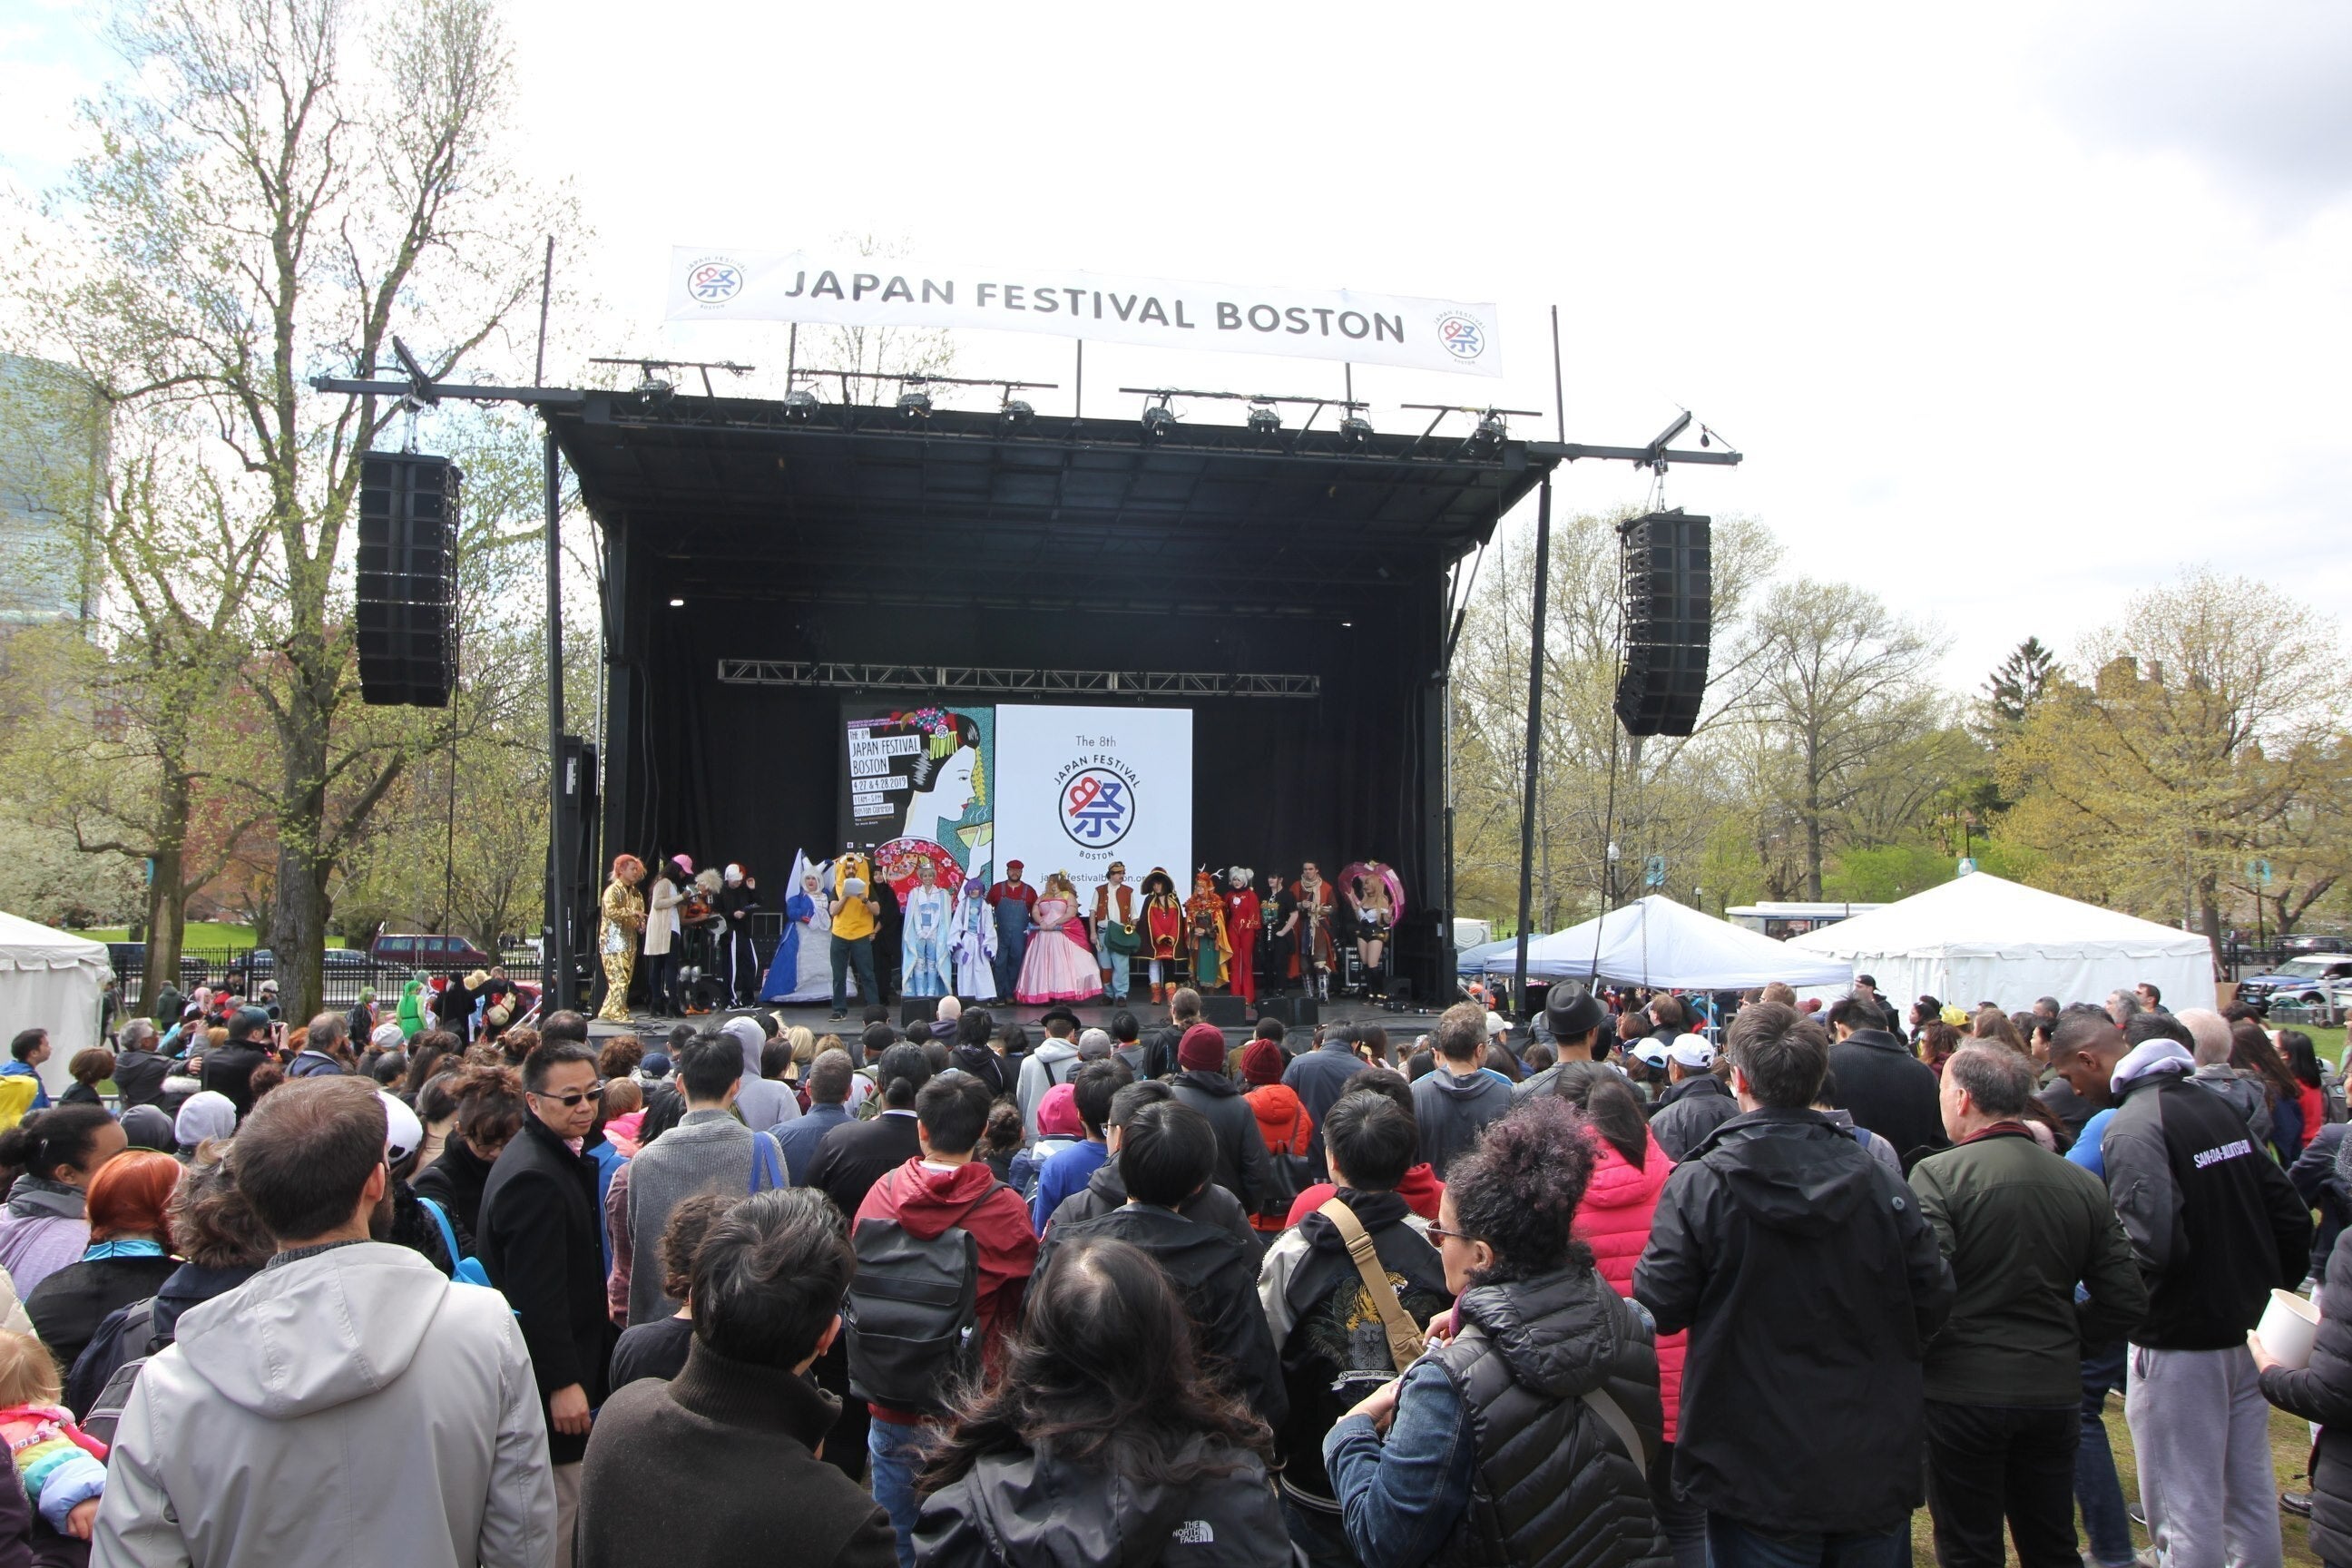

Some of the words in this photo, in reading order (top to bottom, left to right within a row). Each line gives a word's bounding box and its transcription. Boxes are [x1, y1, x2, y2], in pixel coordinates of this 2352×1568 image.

[784, 270, 954, 305] JAPAN
[976, 282, 1195, 329] FESTIVAL
[1216, 301, 1405, 344] BOSTON
[849, 730, 860, 740] THE
[1075, 735, 1095, 748] The
[1099, 736, 1117, 748] 8th
[851, 740, 879, 758] JAPAN
[881, 737, 920, 754] FESTIVAL
[853, 758, 887, 775] BOSTON
[1054, 756, 1088, 786] JAPAN
[1093, 754, 1142, 789] FESTIVAL
[1079, 850, 1114, 860] BOSTON
[1183, 1520, 1200, 1530] THE
[1172, 1528, 1200, 1537] NORTH
[1180, 1535, 1200, 1544] FACE
